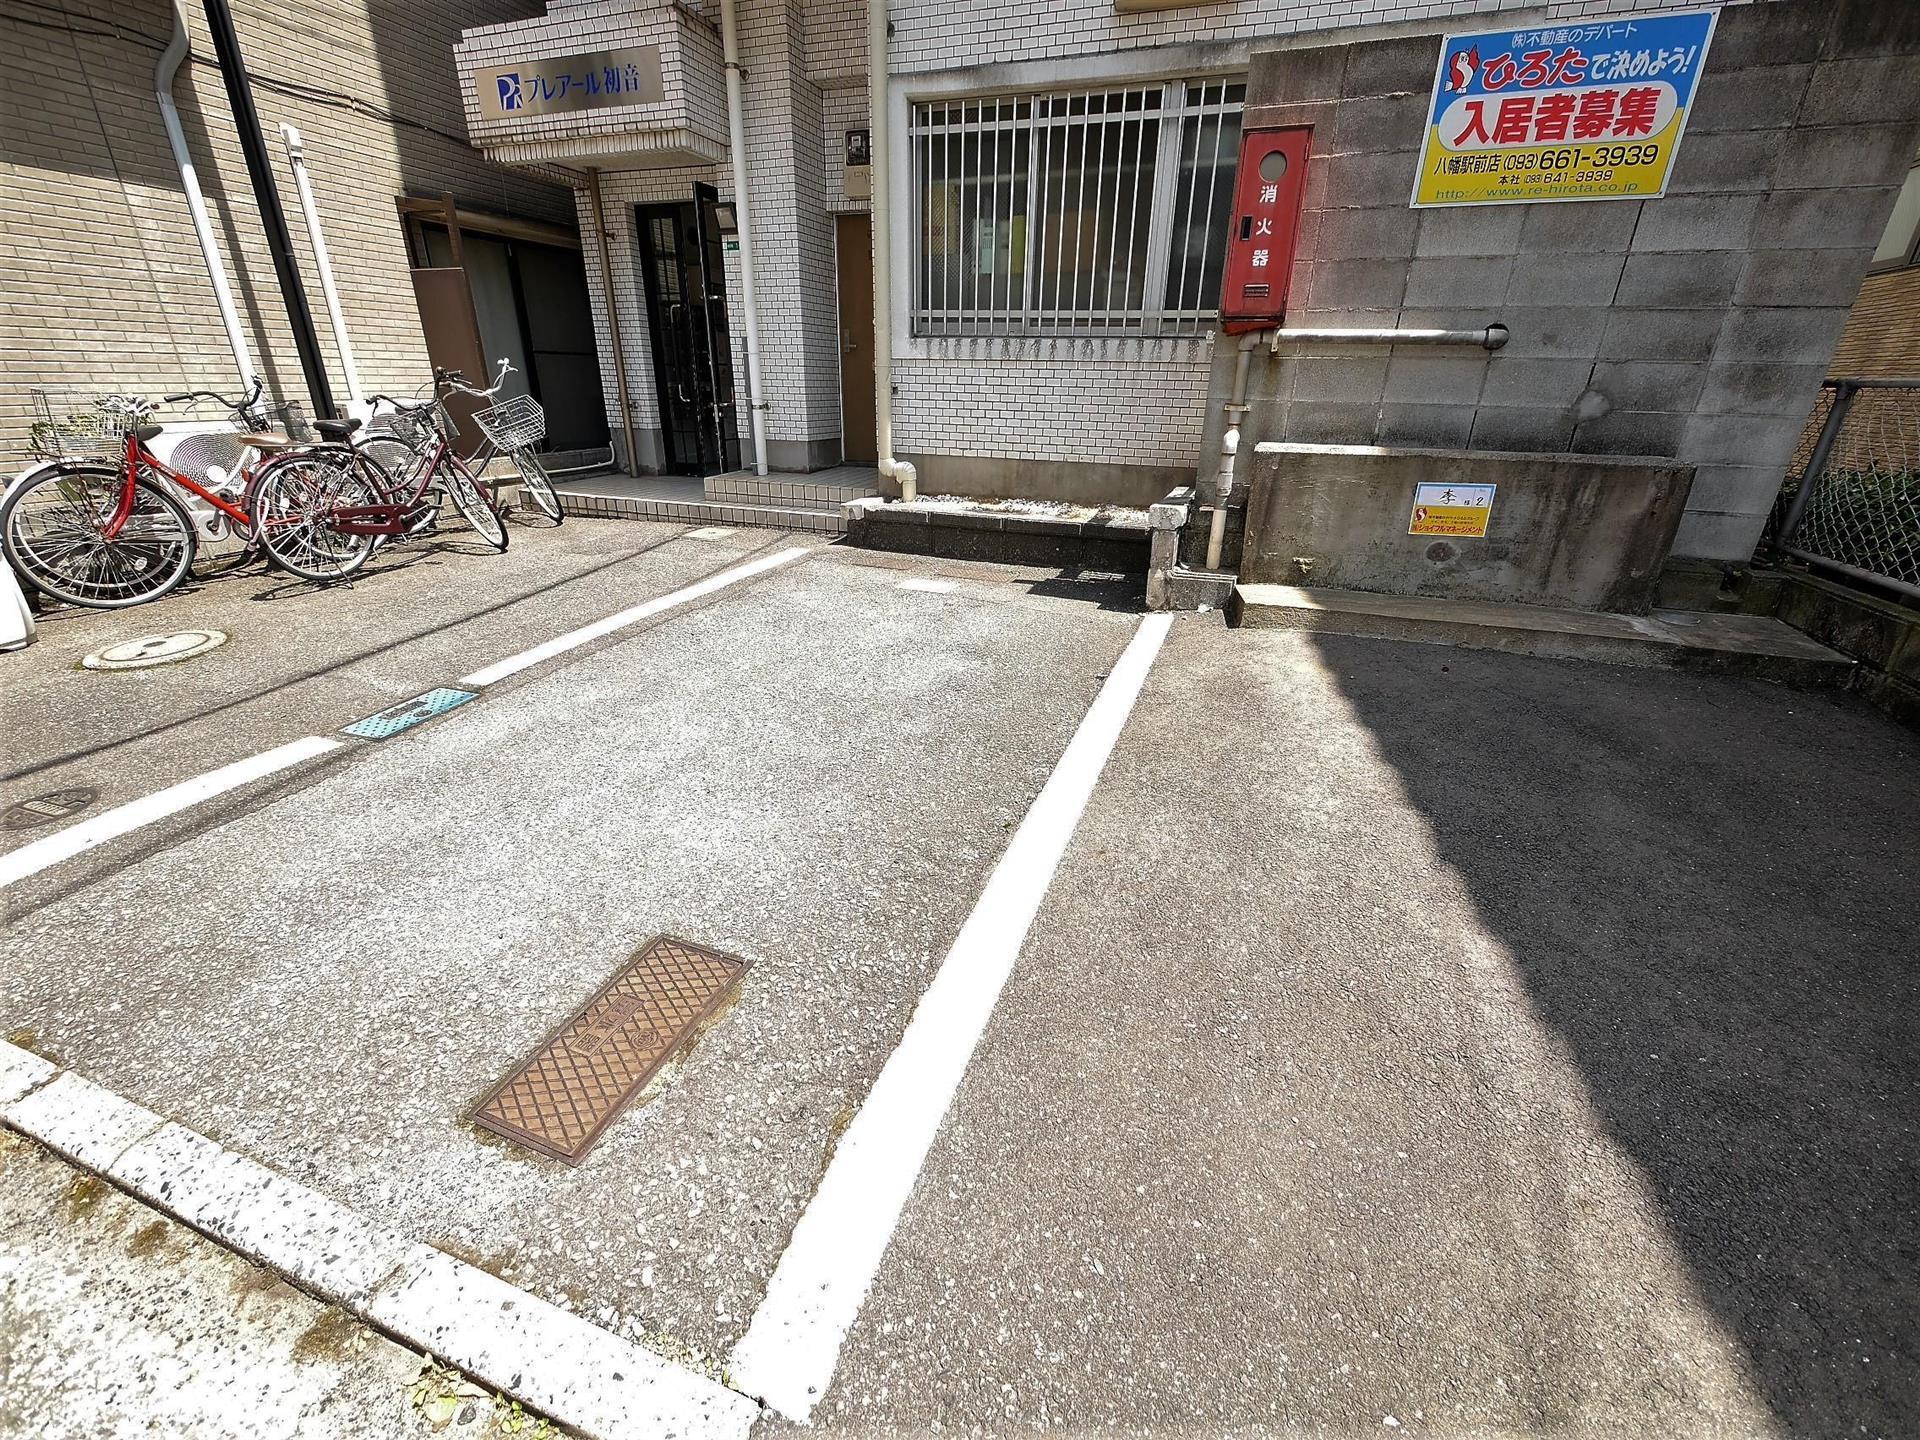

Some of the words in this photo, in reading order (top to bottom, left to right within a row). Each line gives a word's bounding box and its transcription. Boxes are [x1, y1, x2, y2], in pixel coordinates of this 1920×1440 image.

[1453, 86, 1662, 148] 入居者募集
[1498, 174, 1520, 186] 本社
[1436, 182, 1639, 200] http://www.re-hirota.co.jp
[1252, 185, 1278, 267] 消火器
[1475, 496, 1484, 506] 2
